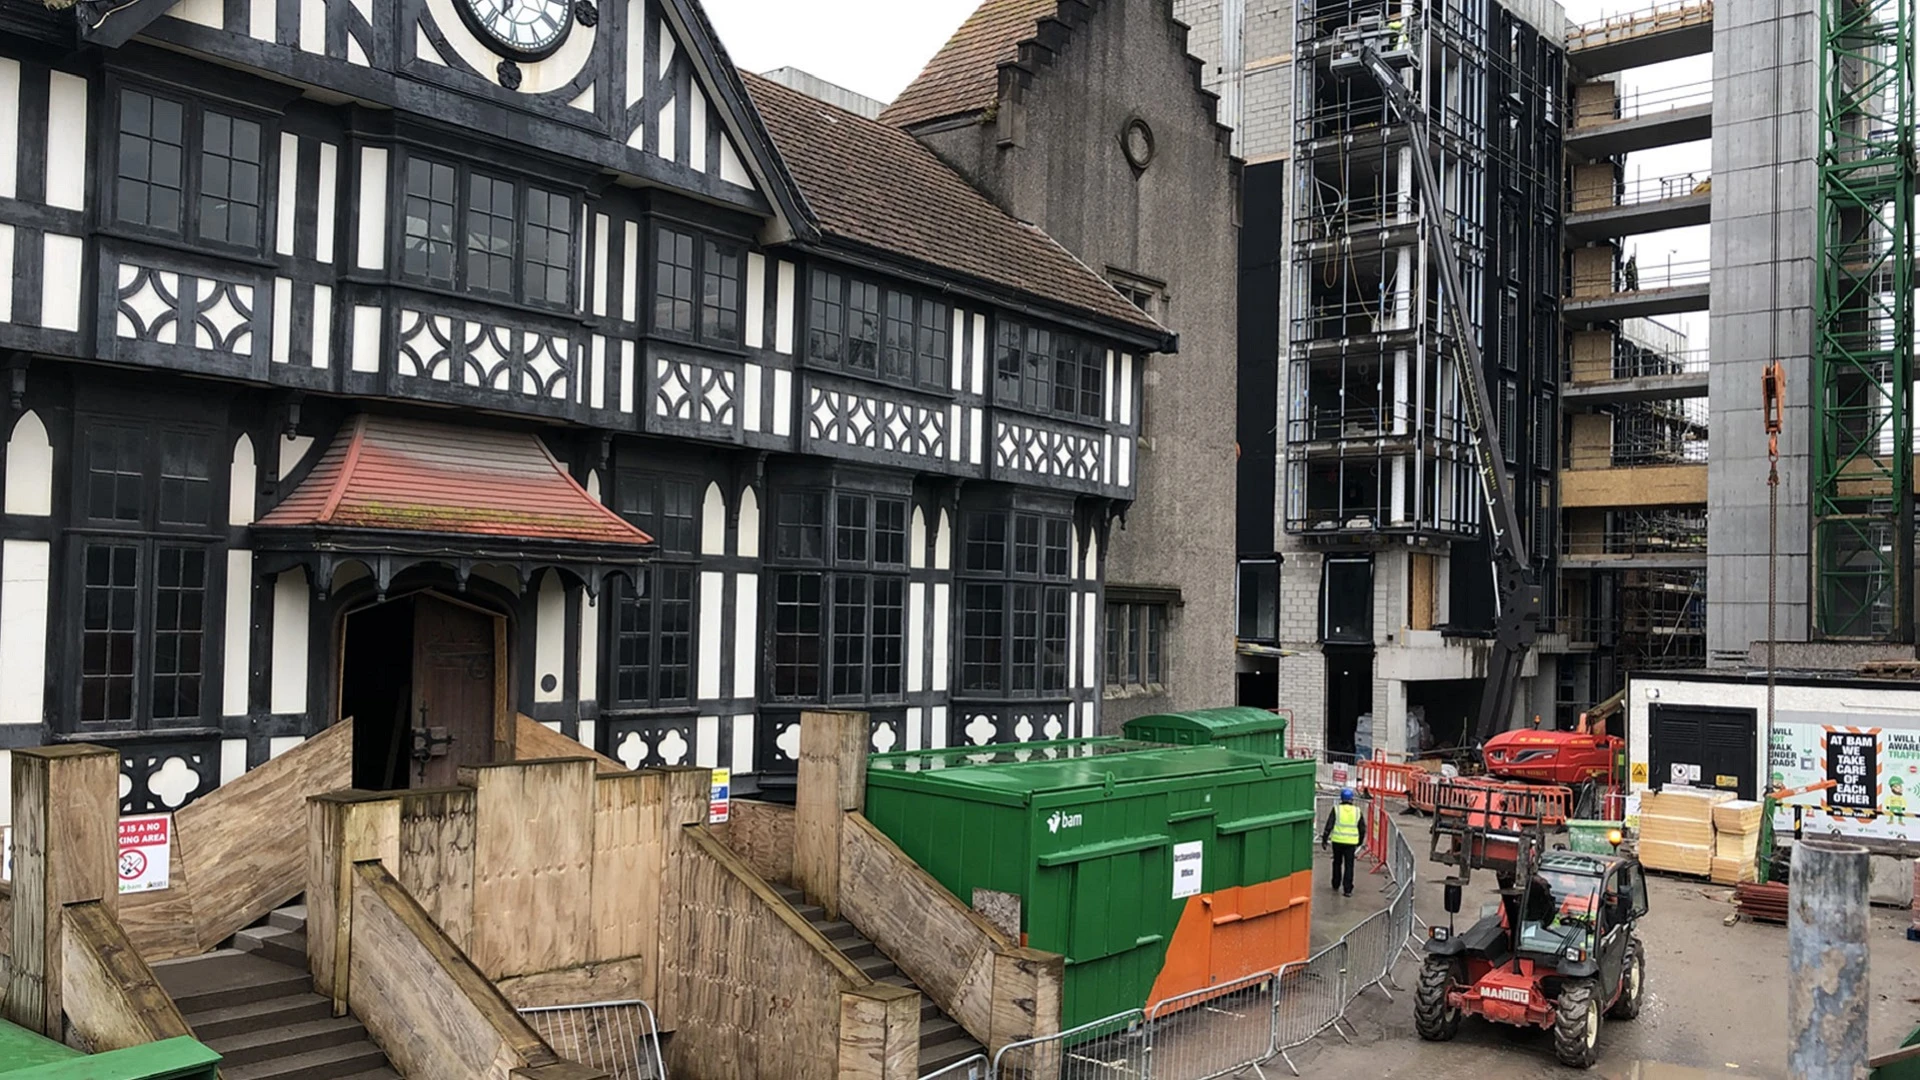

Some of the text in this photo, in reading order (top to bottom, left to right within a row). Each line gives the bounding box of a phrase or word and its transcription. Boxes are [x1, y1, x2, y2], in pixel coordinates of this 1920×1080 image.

[1830, 735, 1873, 747] AT BAM
[1893, 734, 1916, 743] WILL
[1842, 745, 1861, 756] WE
[1837, 754, 1866, 766] TAKE
[1836, 765, 1867, 776] CARE
[1843, 774, 1860, 785] OF
[1836, 783, 1867, 795] EACH
[1832, 792, 1870, 805] OTHER
[1062, 810, 1083, 828] bam
[126, 824, 136, 833] IS
[138, 823, 145, 832] A
[146, 822, 160, 831] NO
[119, 833, 165, 845] KING AREA
[1480, 986, 1530, 1005] MANITOU
